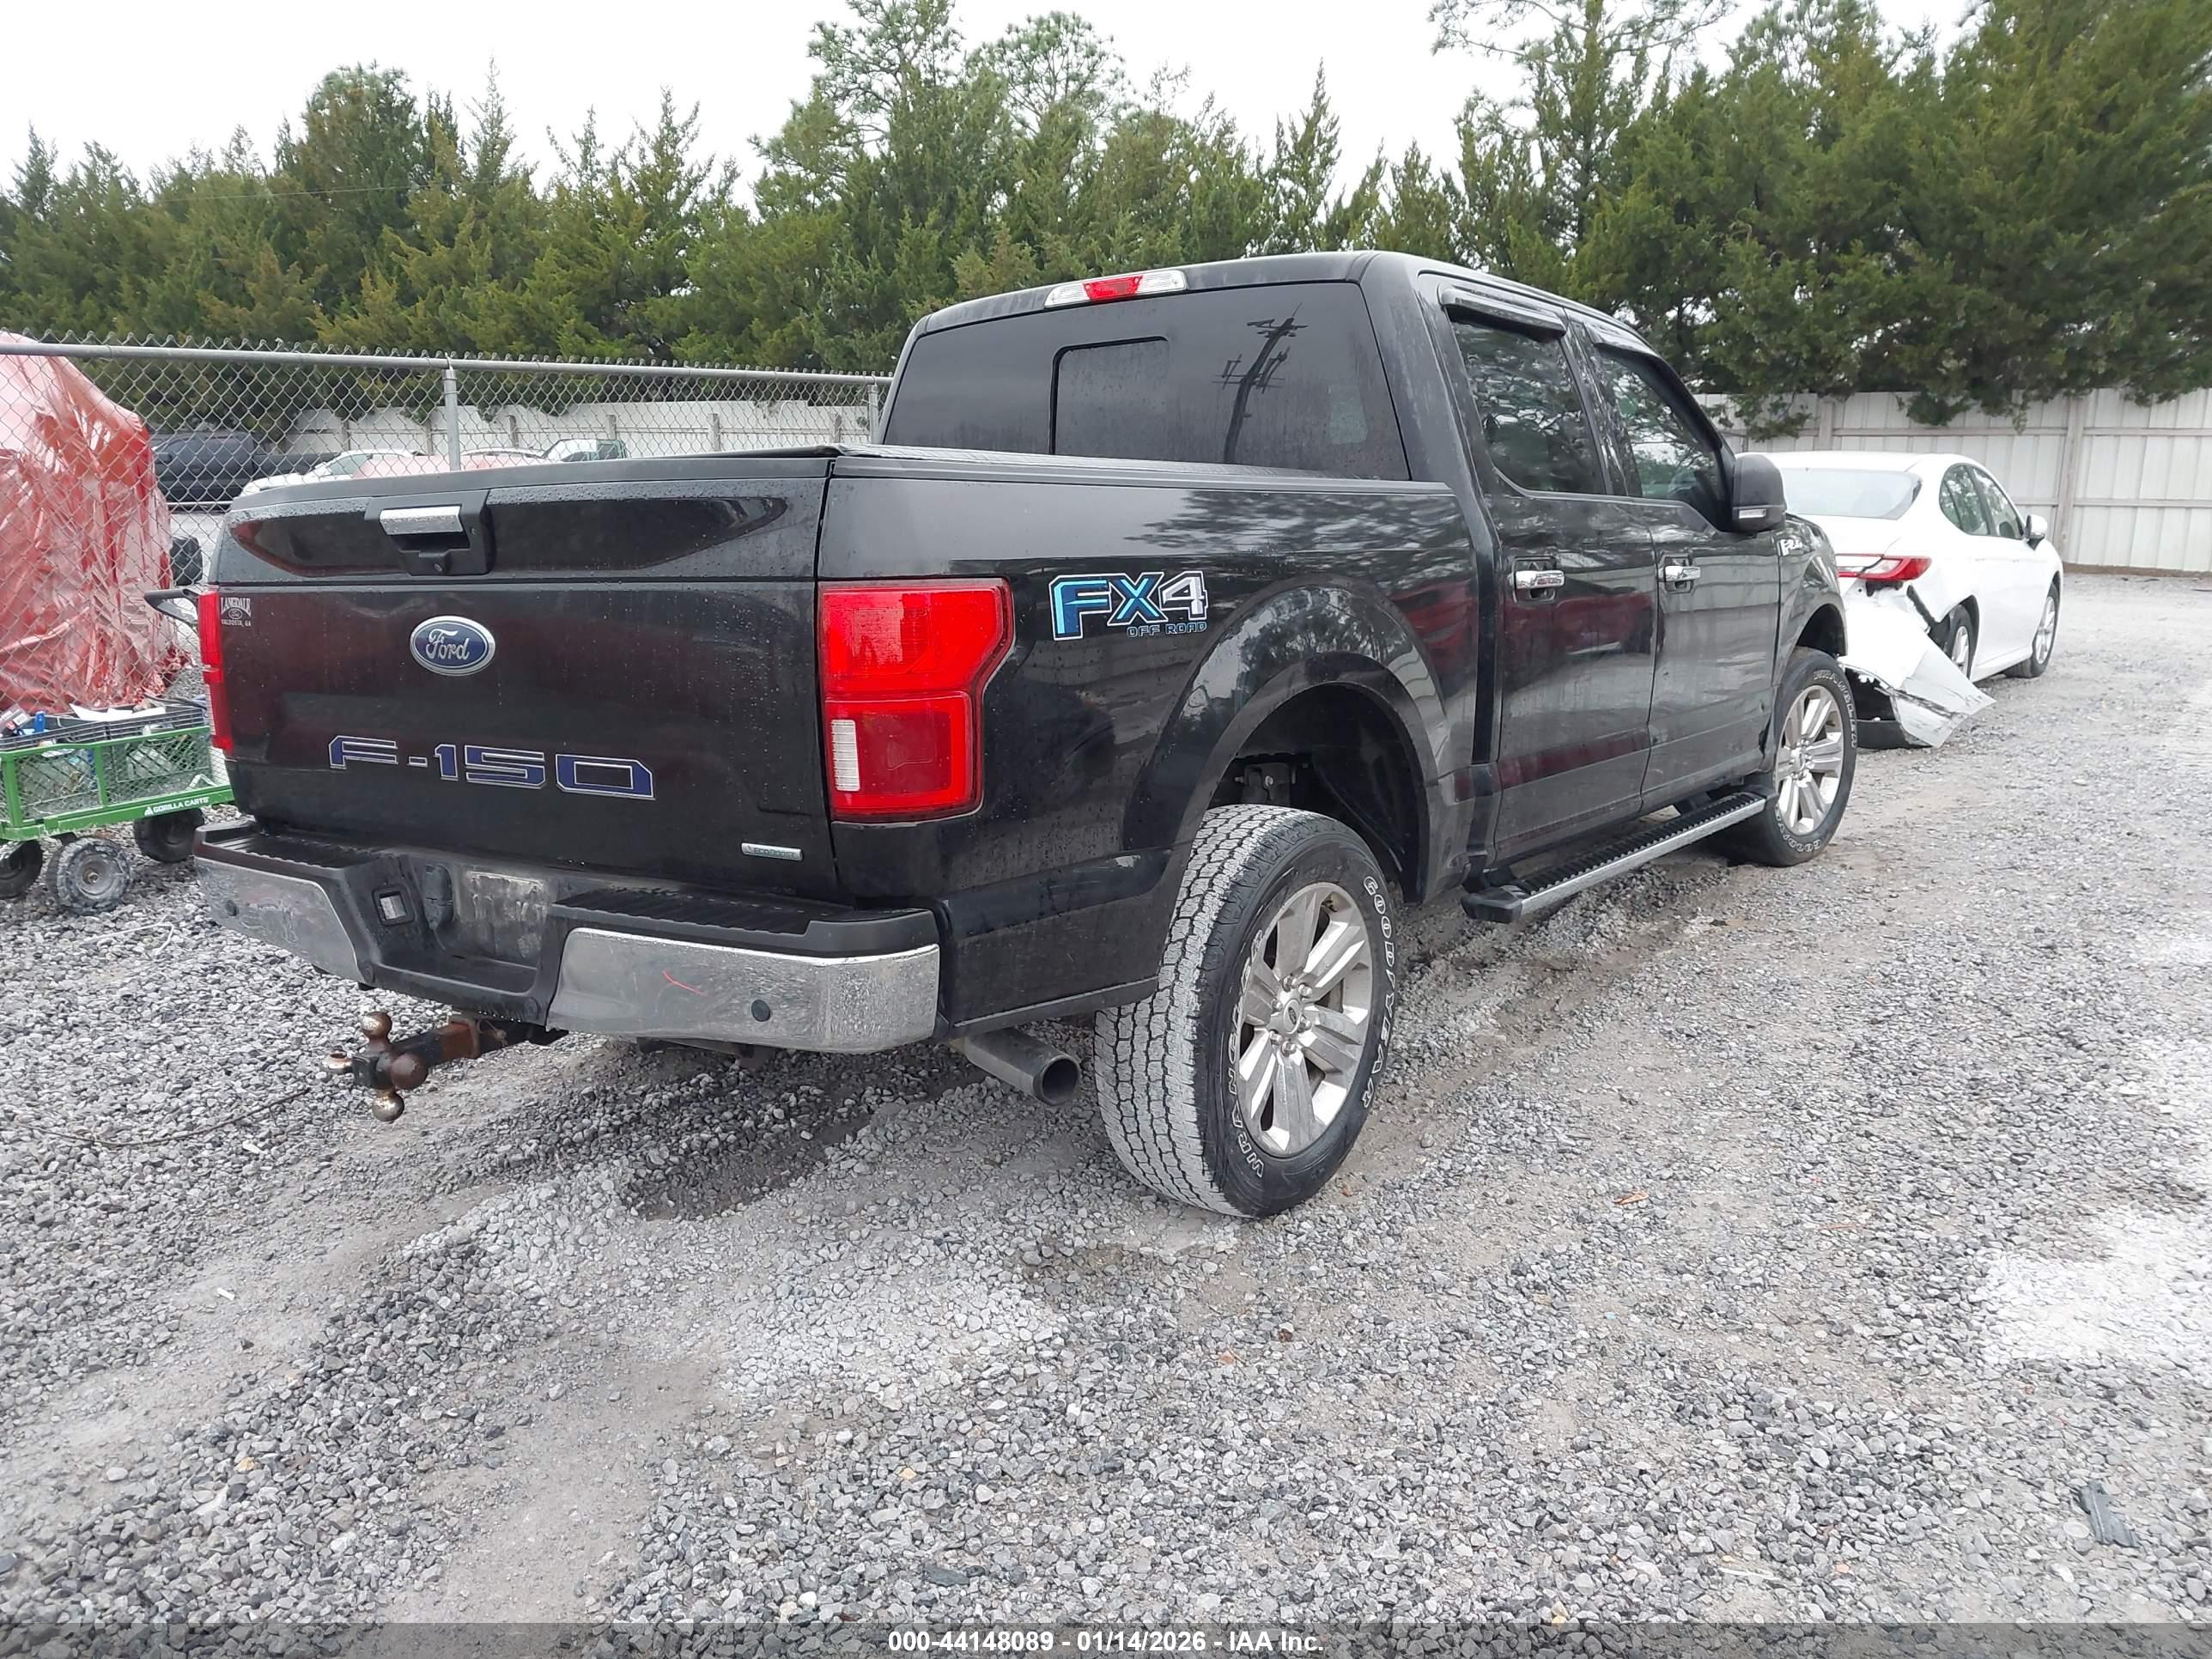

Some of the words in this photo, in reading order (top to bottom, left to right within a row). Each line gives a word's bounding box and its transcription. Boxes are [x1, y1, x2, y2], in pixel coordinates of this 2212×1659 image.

[1048, 571, 1208, 641] FX4
[1127, 625, 1160, 638] OFF
[1165, 621, 1207, 635] ROAD
[425, 629, 470, 660] Ford
[328, 735, 656, 801] F-150
[153, 802, 184, 813] GORILLA
[184, 797, 209, 807] CARTS
[1364, 876, 1396, 1109] GOODYEAR
[1227, 929, 1264, 1179] WRANGLER
